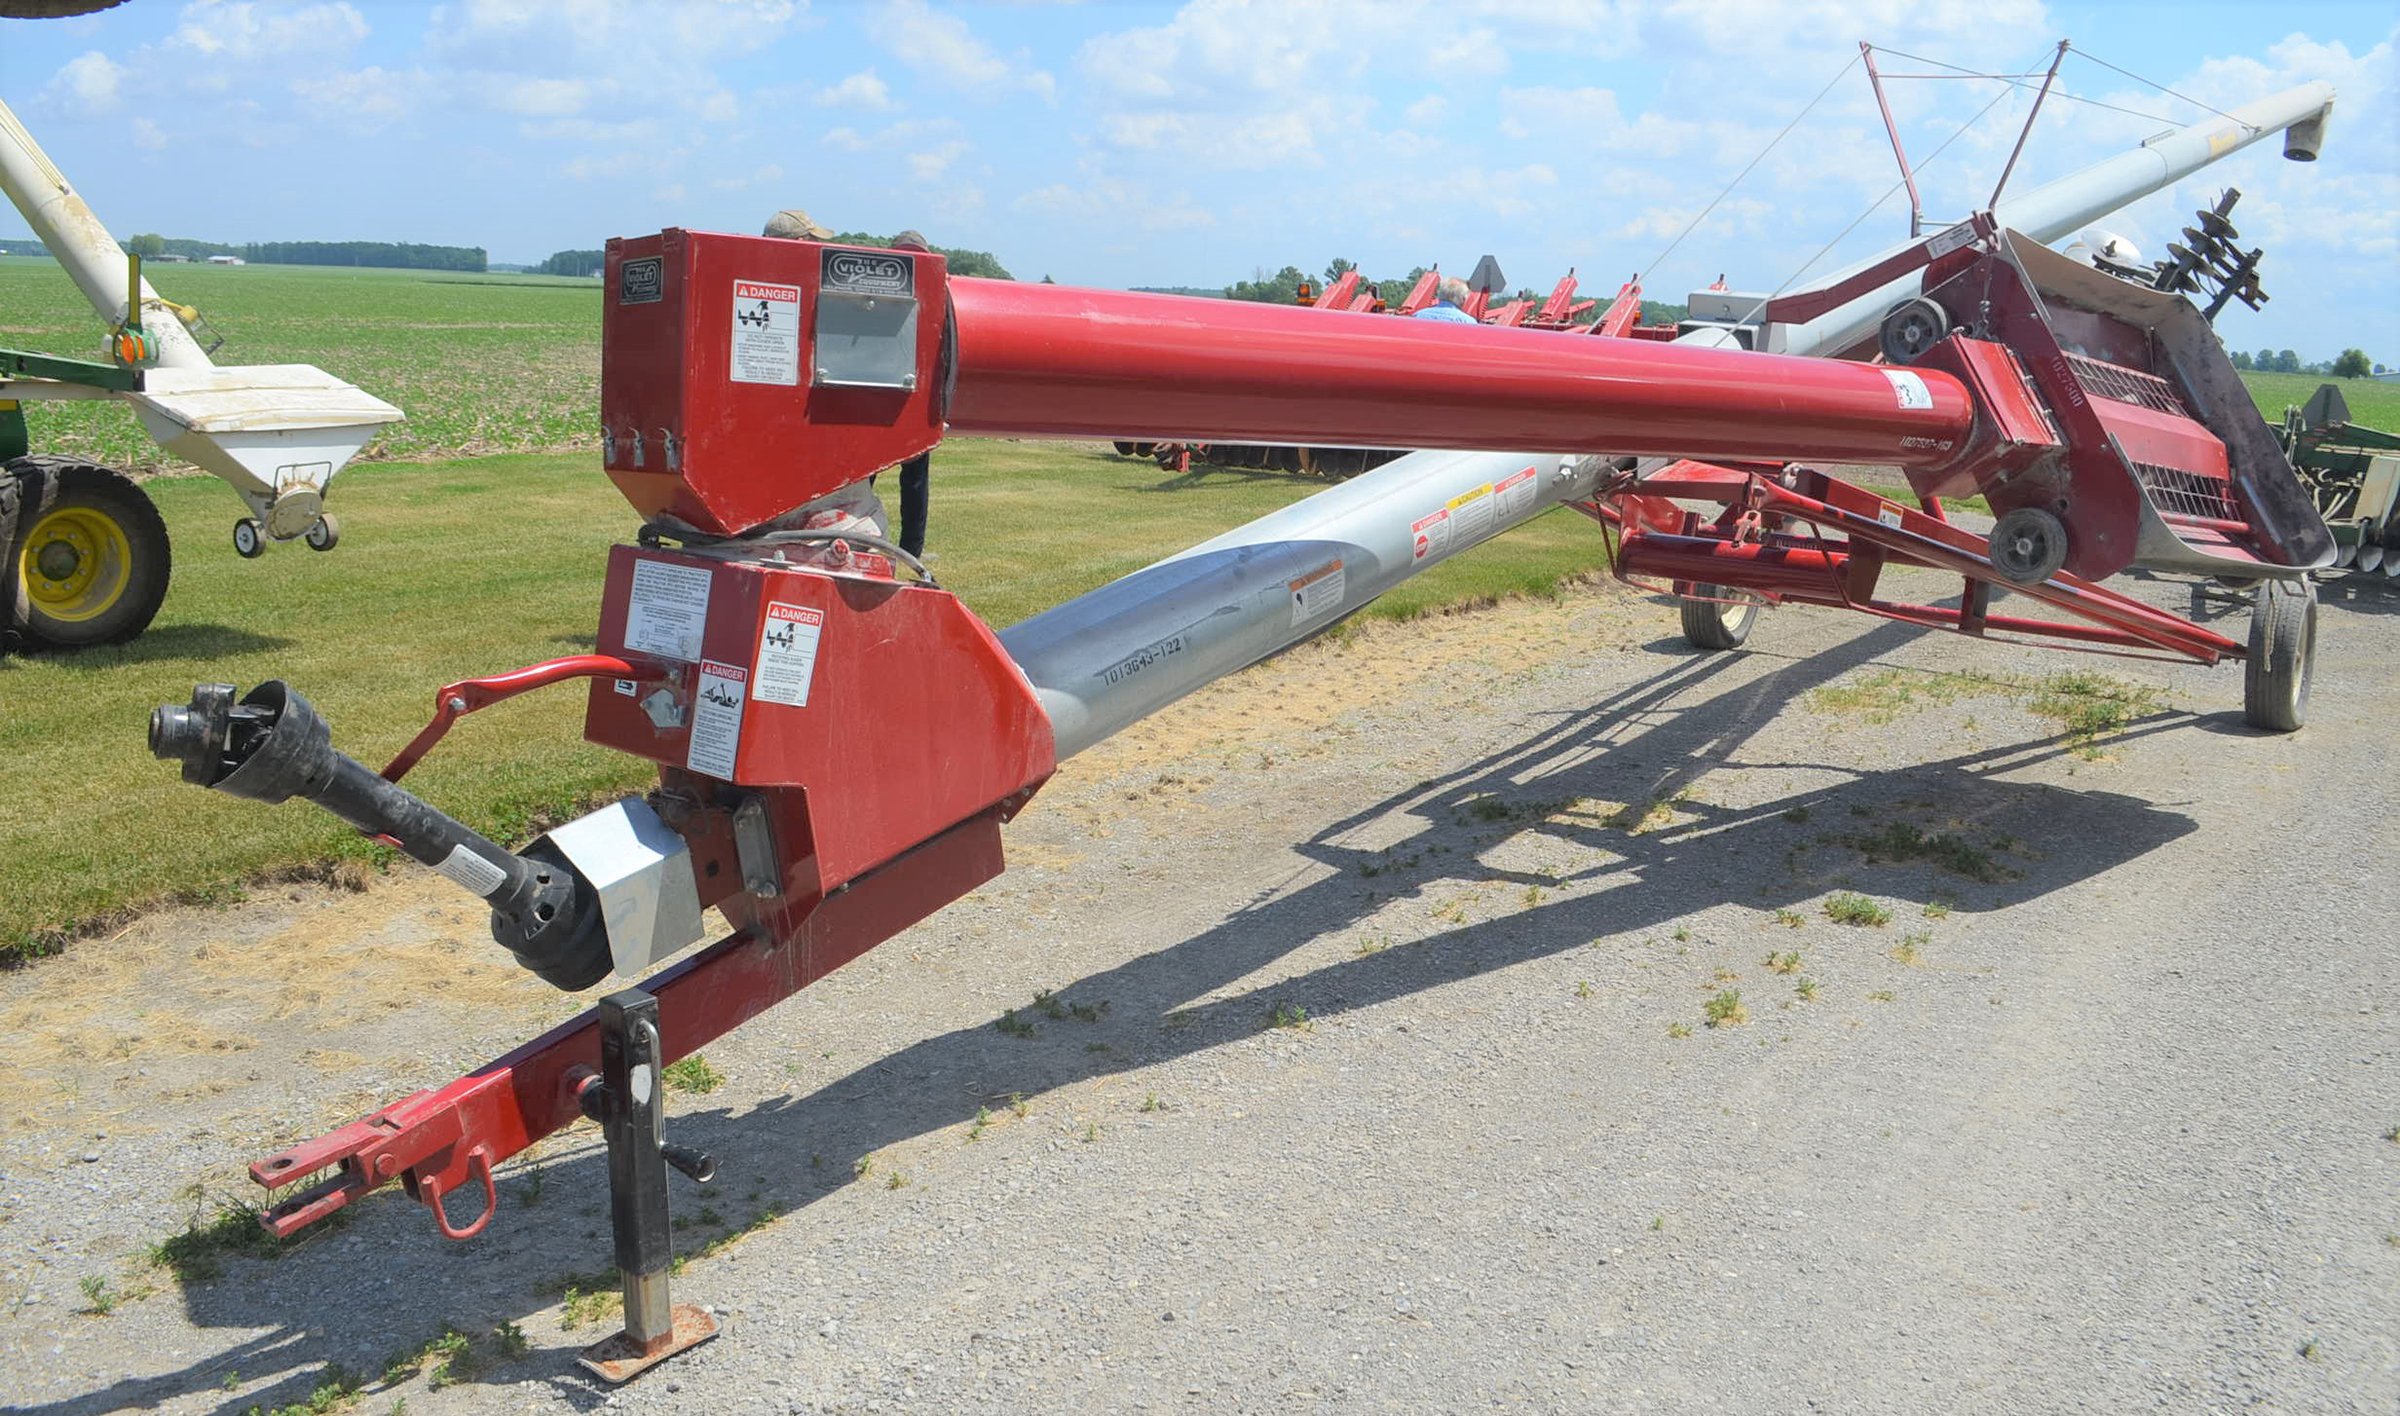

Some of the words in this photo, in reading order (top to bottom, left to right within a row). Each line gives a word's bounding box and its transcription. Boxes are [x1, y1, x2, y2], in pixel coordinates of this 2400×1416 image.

[839, 263, 895, 276] VIOLET
[859, 279, 901, 287] EQUIPMENT
[750, 286, 796, 302] DANGER
[780, 608, 819, 625] DANGER
[1103, 637, 1182, 686] 1013643-122
[712, 664, 743, 681] DANGER
